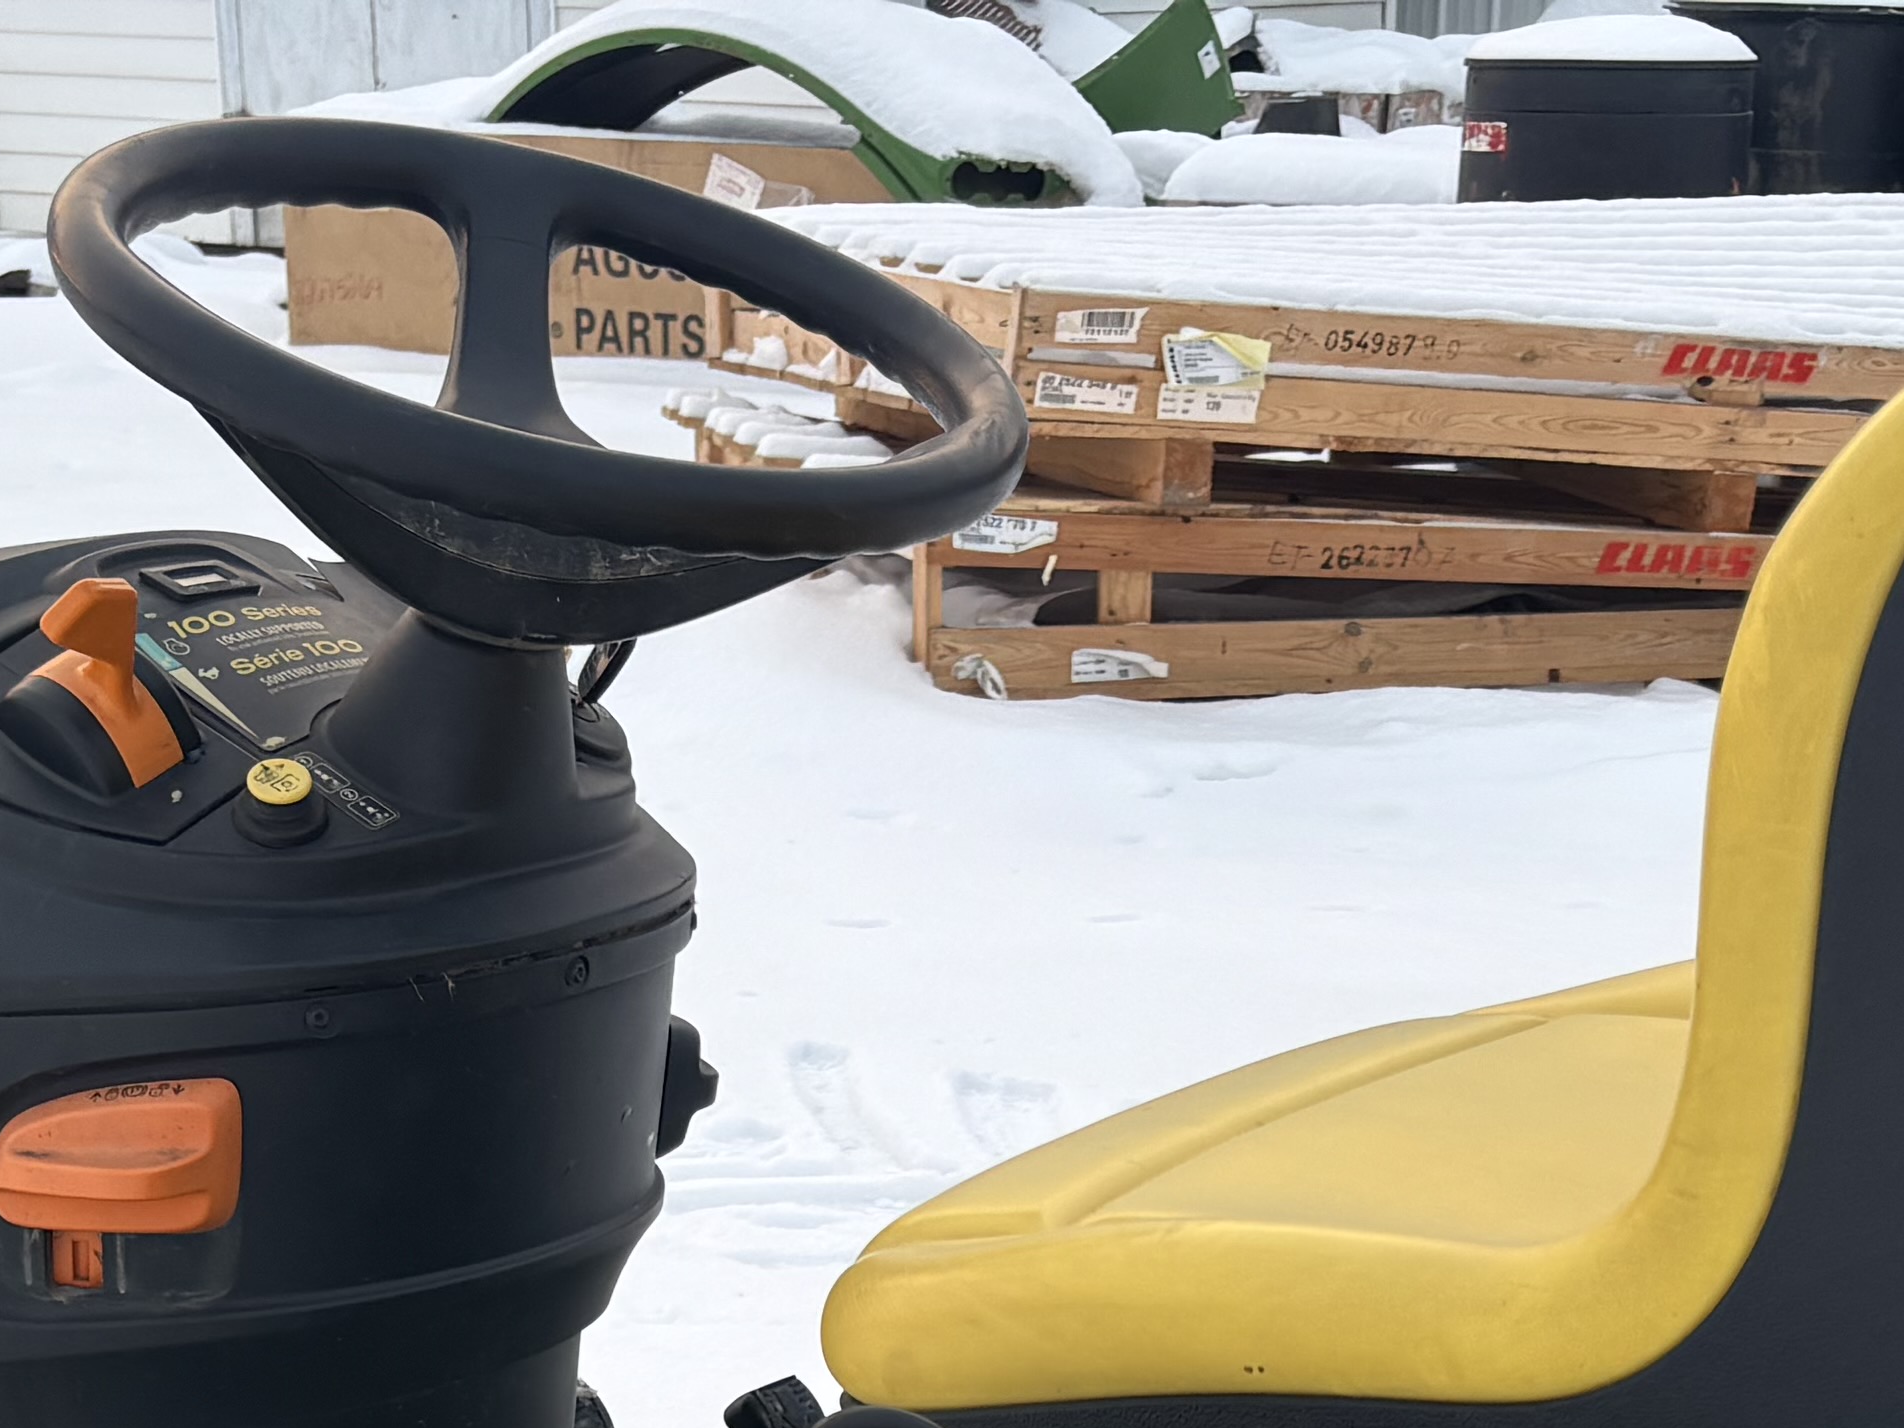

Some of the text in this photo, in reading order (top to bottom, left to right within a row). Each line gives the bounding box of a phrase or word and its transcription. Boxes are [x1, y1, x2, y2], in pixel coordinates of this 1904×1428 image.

[574, 307, 706, 359] PARTS
[1661, 342, 1819, 384] CLAAS
[1595, 540, 1758, 579] CLAAS
[167, 603, 322, 640] 100 Series
[230, 648, 305, 675] Série
[302, 639, 363, 657] 100
